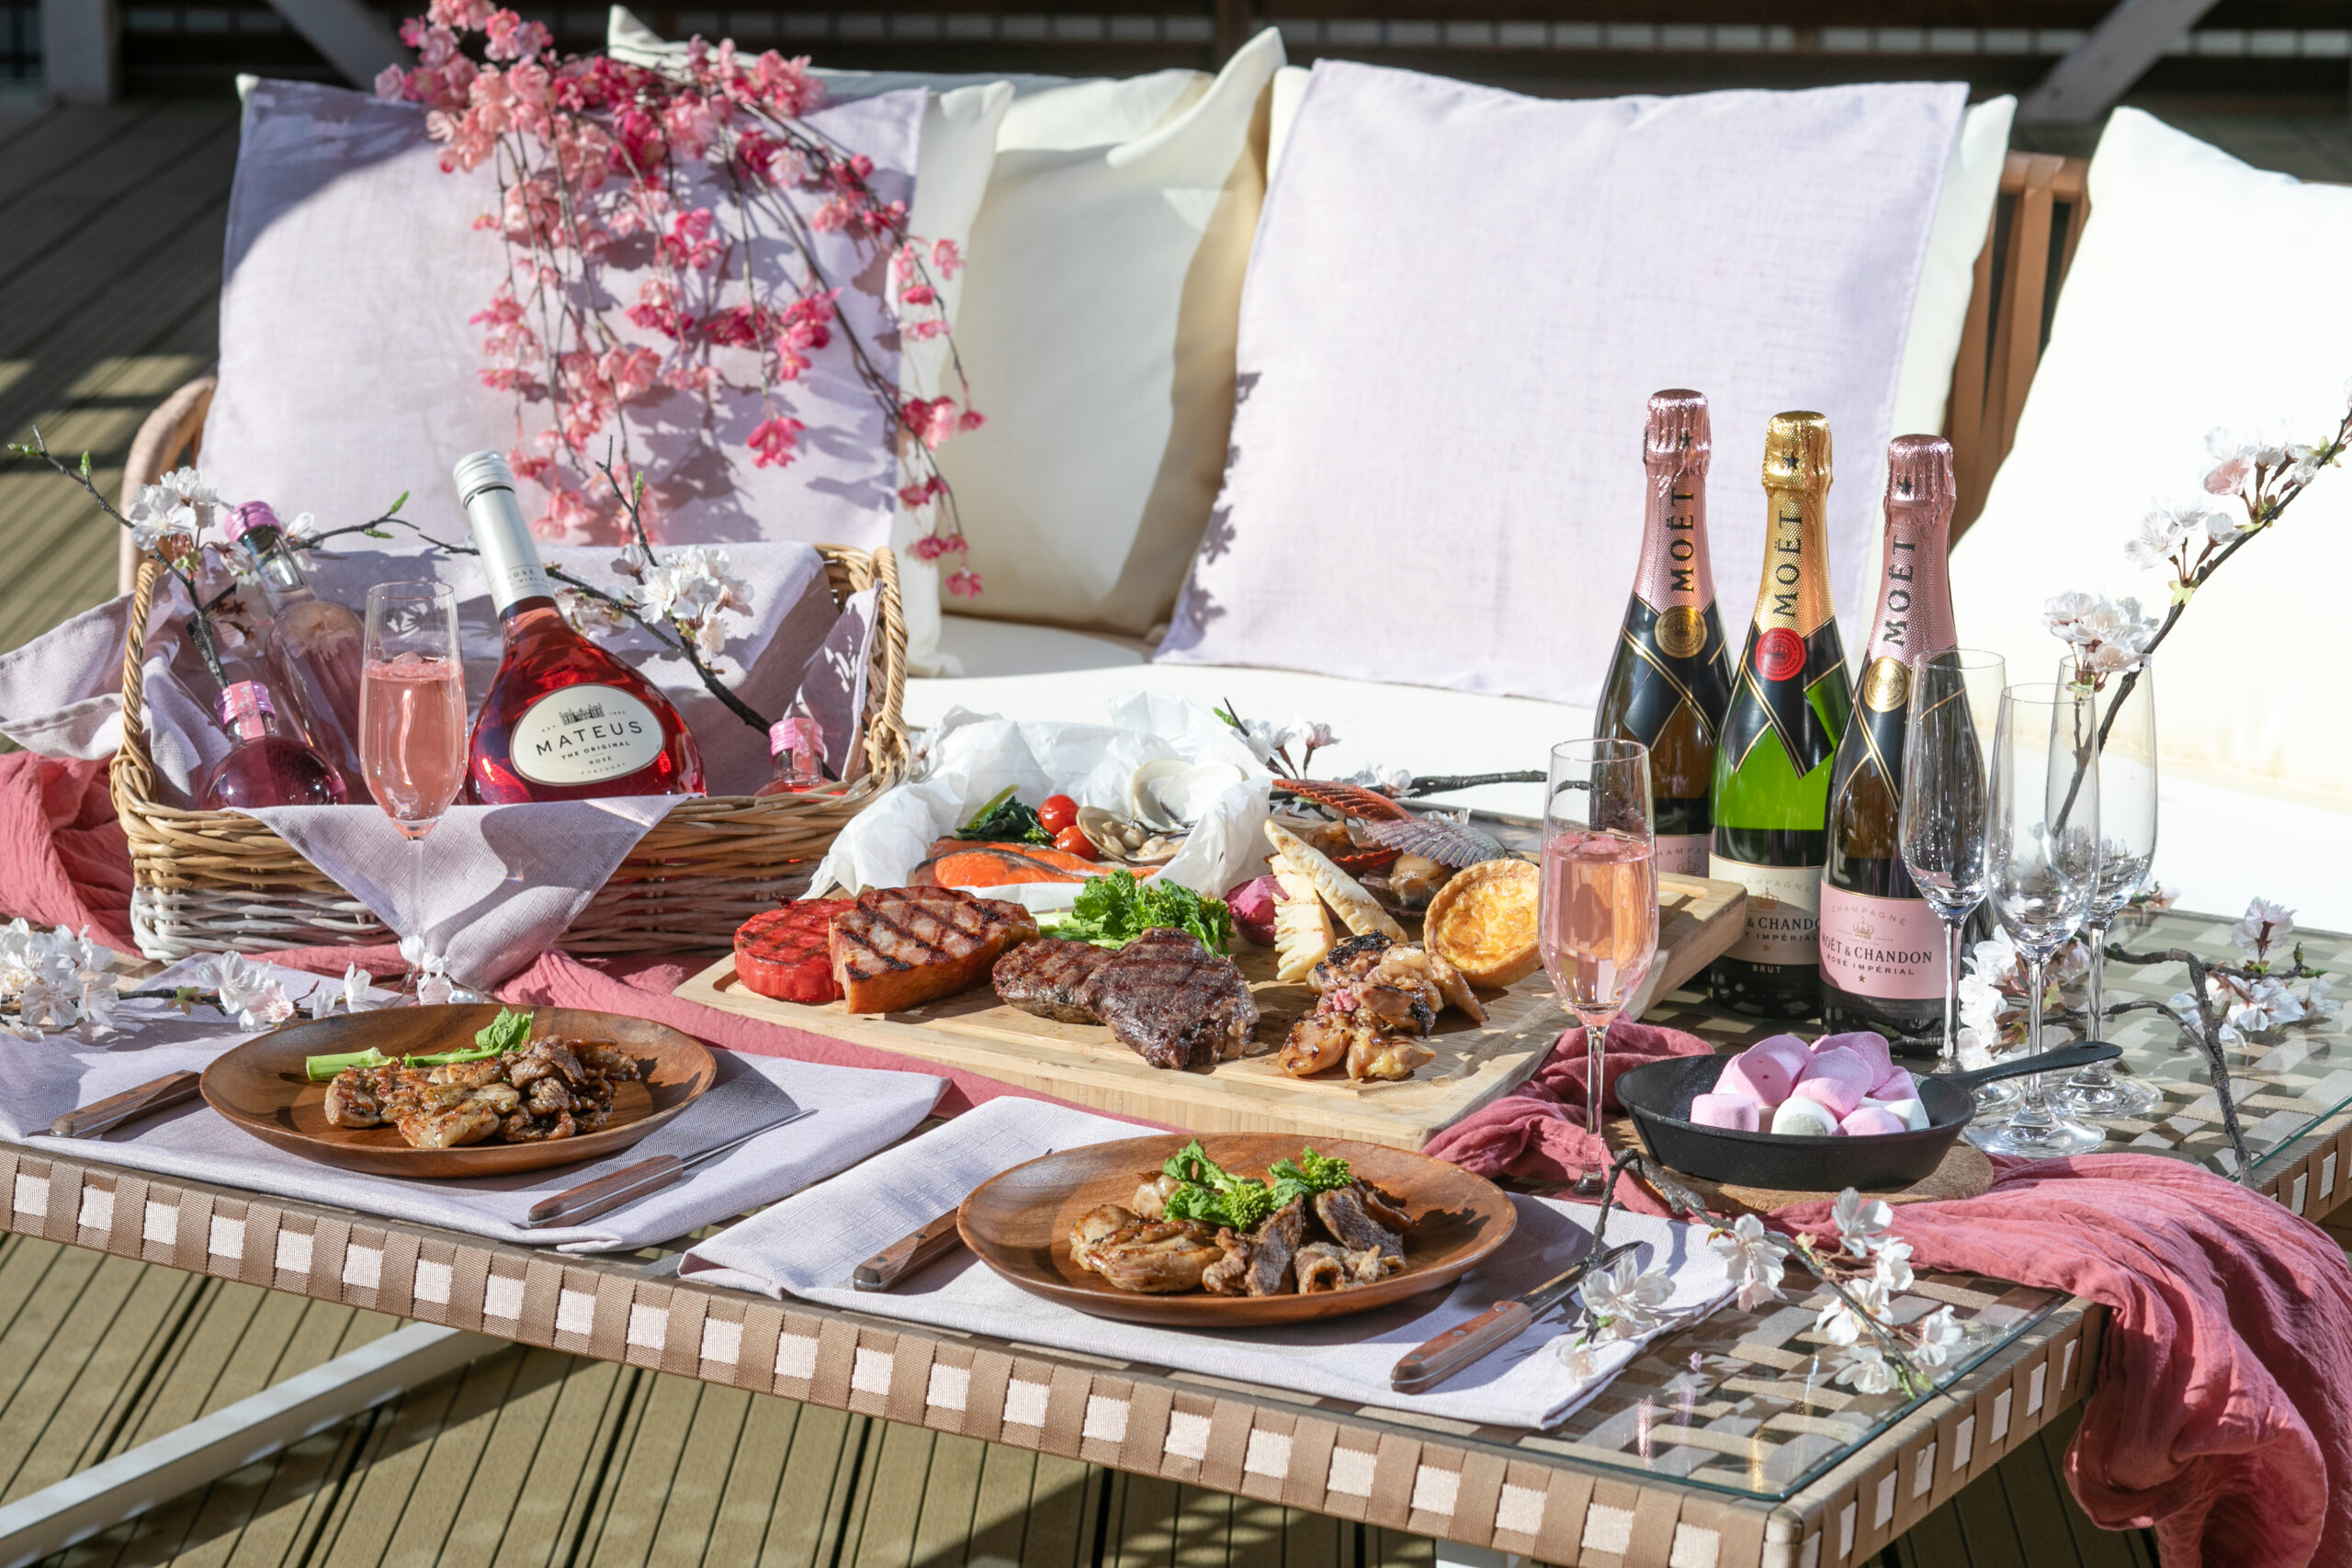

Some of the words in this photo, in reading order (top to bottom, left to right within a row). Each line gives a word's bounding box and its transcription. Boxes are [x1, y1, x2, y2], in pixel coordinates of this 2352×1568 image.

[1666, 487, 1694, 592] MOËT
[1773, 510, 1803, 617] MOËT
[1883, 536, 1916, 647] MOËT
[536, 721, 642, 756] MATEUS
[561, 751, 579, 761] THE
[583, 741, 631, 753] ORIGINAL
[1747, 919, 1755, 929] &
[1831, 905, 1907, 926] CHAMPAGNE
[1844, 945, 1851, 957] &
[1854, 946, 1932, 964] CHANDON
[1752, 964, 1782, 974] BRUT
[1852, 963, 1916, 976] IMPÉRIAL
